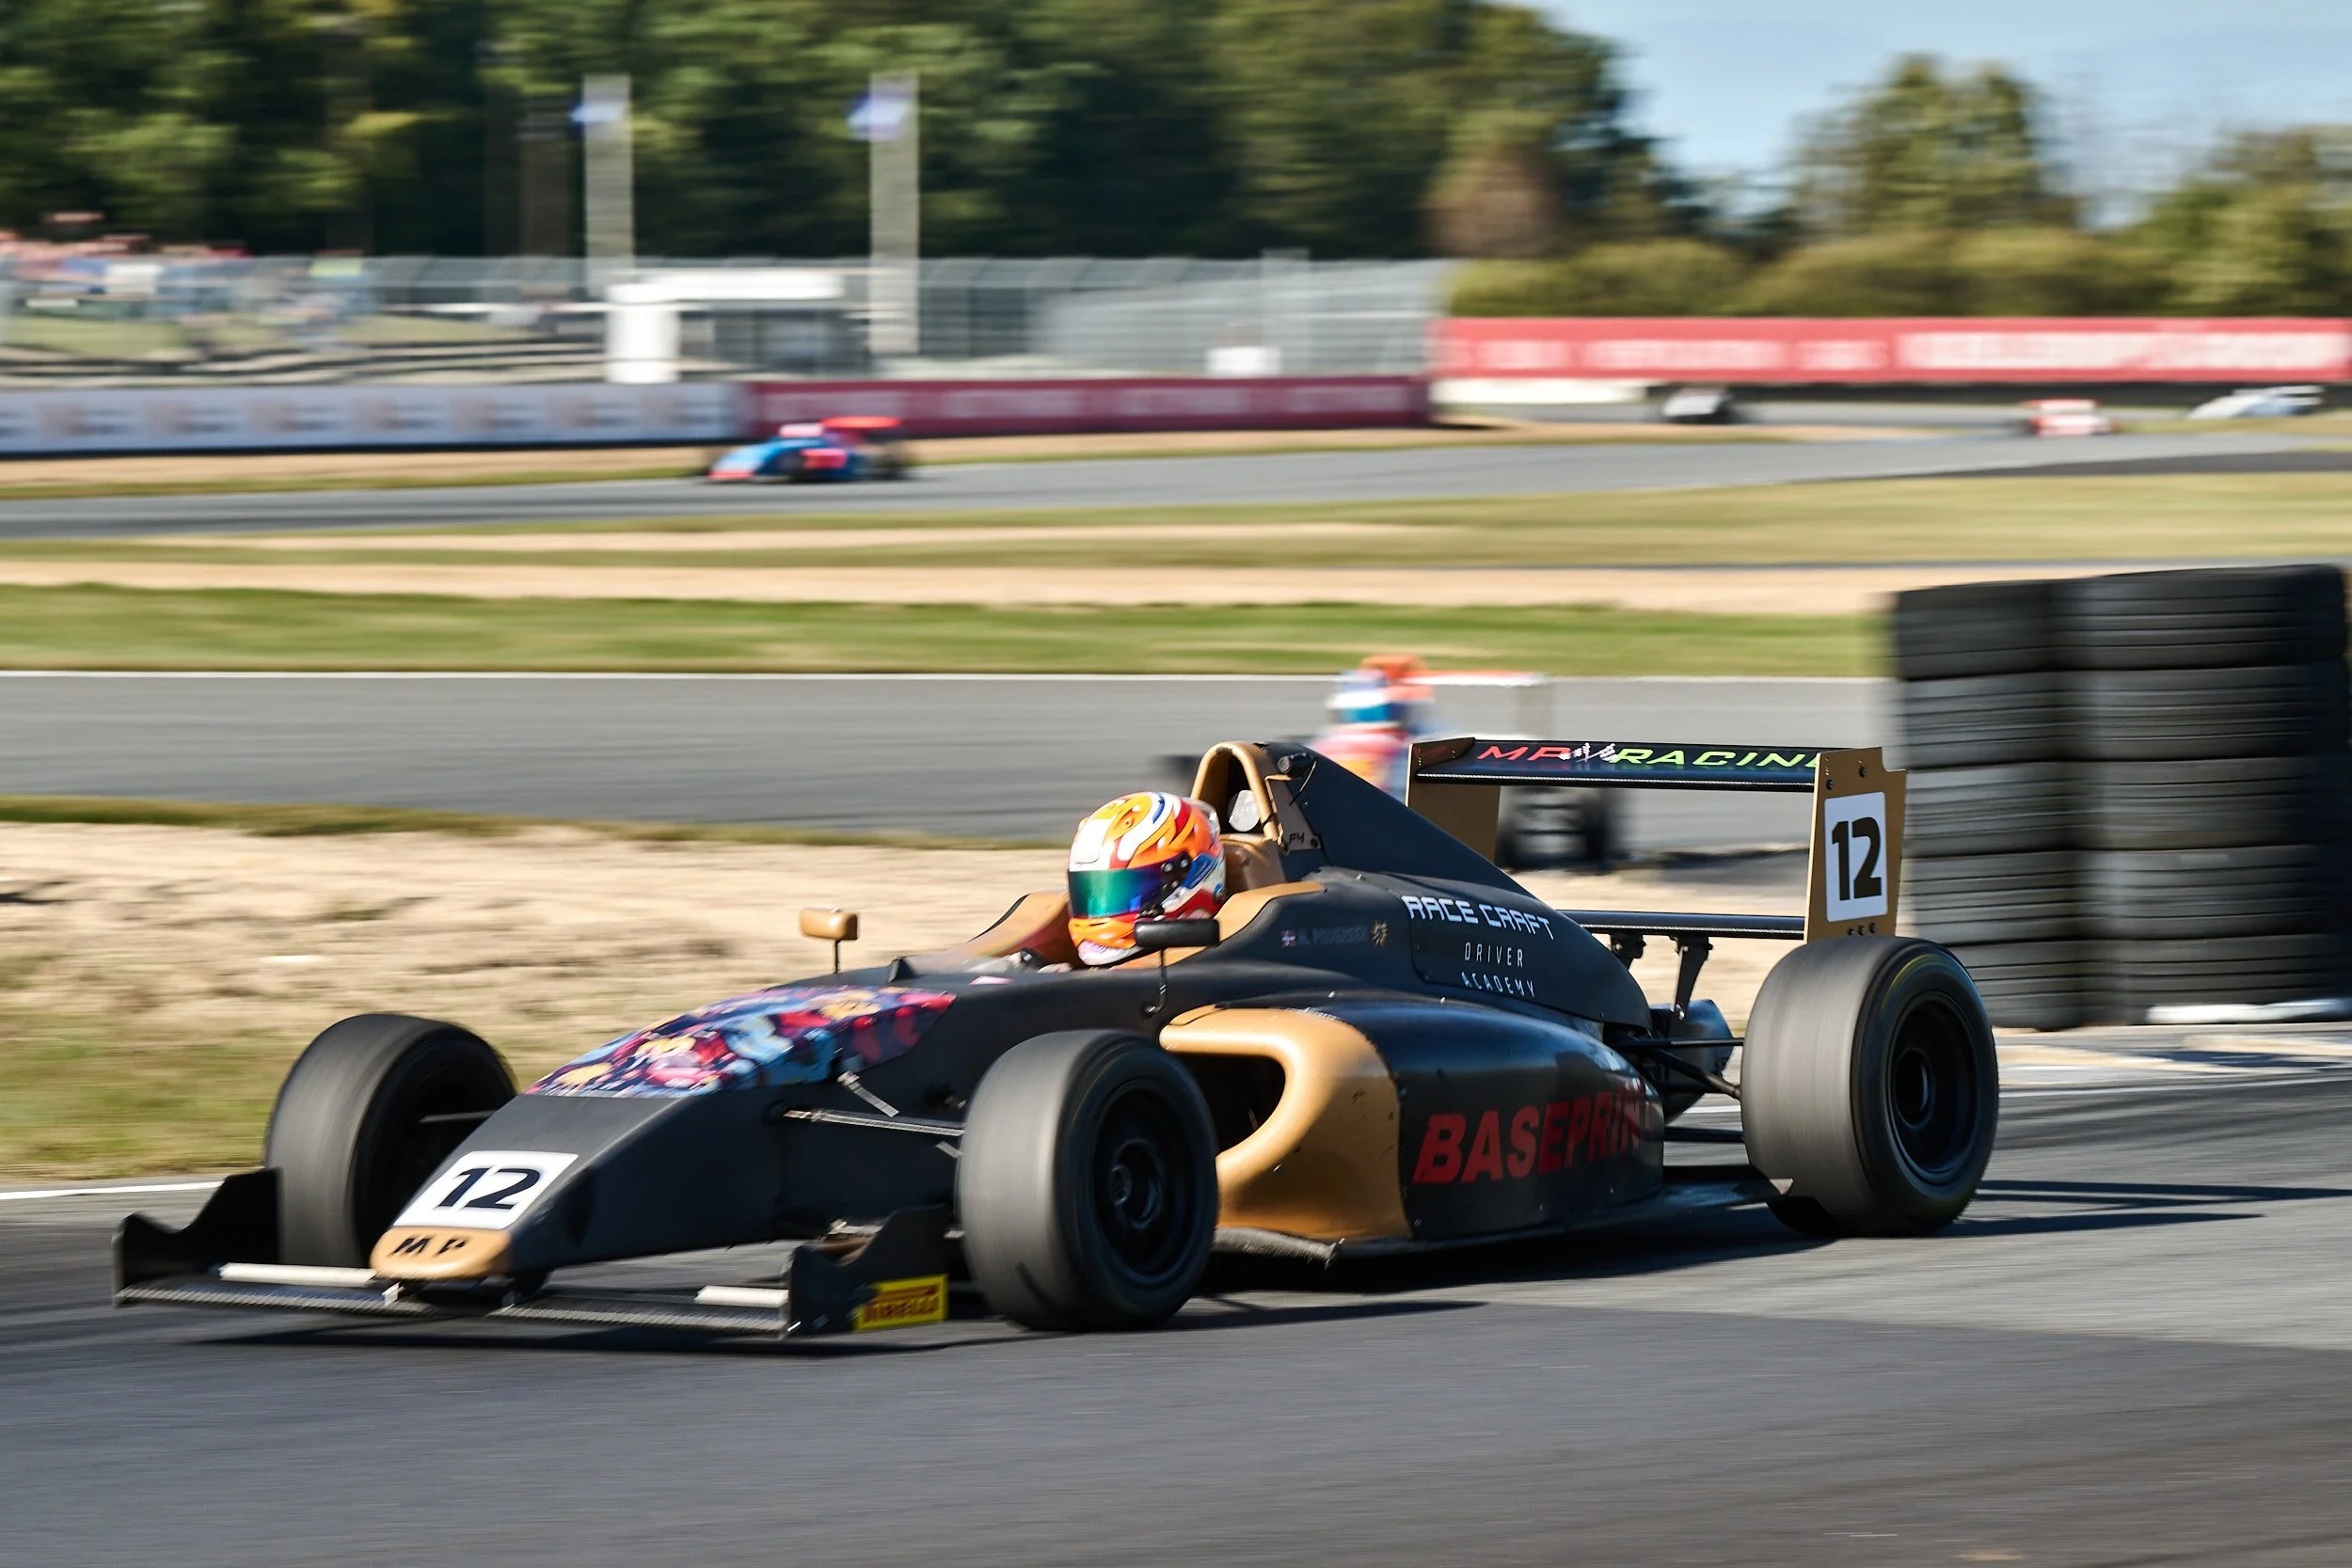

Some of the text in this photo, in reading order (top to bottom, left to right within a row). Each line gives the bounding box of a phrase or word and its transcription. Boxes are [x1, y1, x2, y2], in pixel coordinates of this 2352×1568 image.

[1611, 748, 1818, 768] RACIN
[1831, 816, 1882, 901] 12
[1401, 895, 1554, 940] RACE CRAFT
[1464, 942, 1523, 968] DRIVER
[1461, 971, 1534, 997] ACADEMY
[437, 1167, 541, 1210] 12
